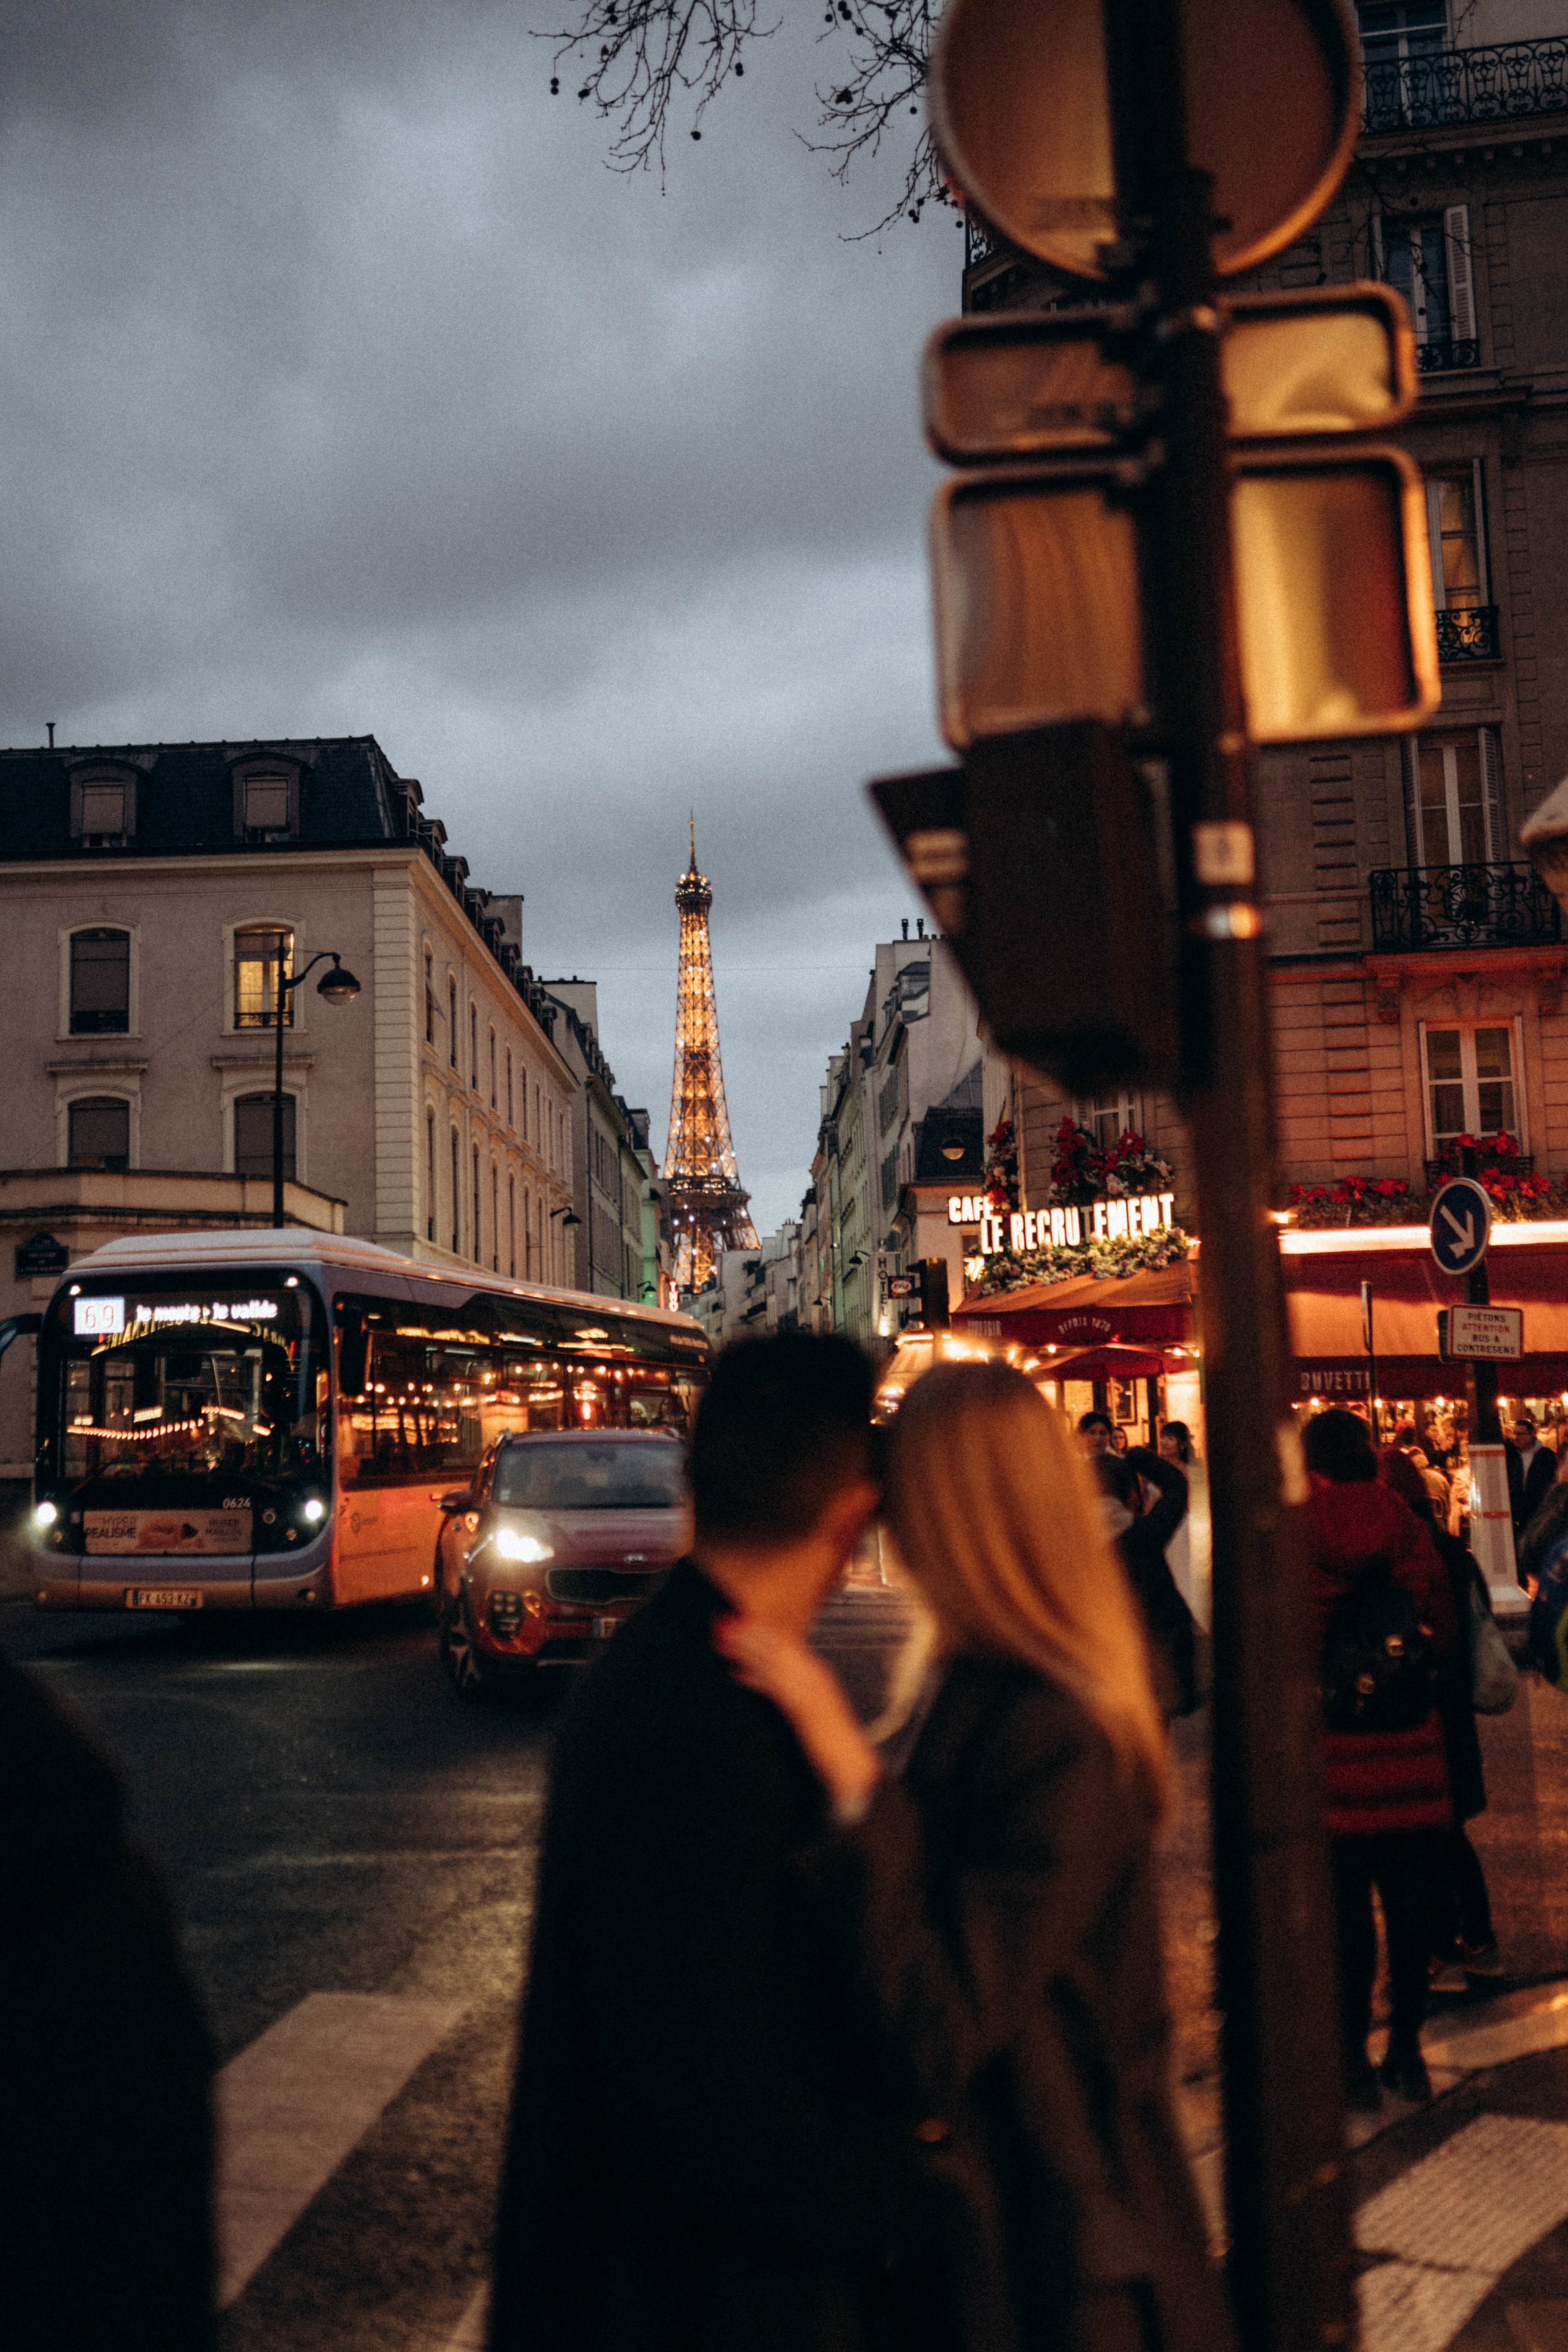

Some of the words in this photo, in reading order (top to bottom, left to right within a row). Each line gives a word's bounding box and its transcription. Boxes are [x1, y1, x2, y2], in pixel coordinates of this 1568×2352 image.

[981, 1215, 1003, 1254] LE
[878, 1257, 888, 1316] HOTEL
[85, 1305, 115, 1328] 69
[1462, 1323, 1510, 1334] ATTENTION
[1472, 1334, 1490, 1343] BUS
[1457, 1344, 1516, 1355] CONTRESENS
[222, 1498, 251, 1509] 0624
[154, 1593, 174, 1605] 453
